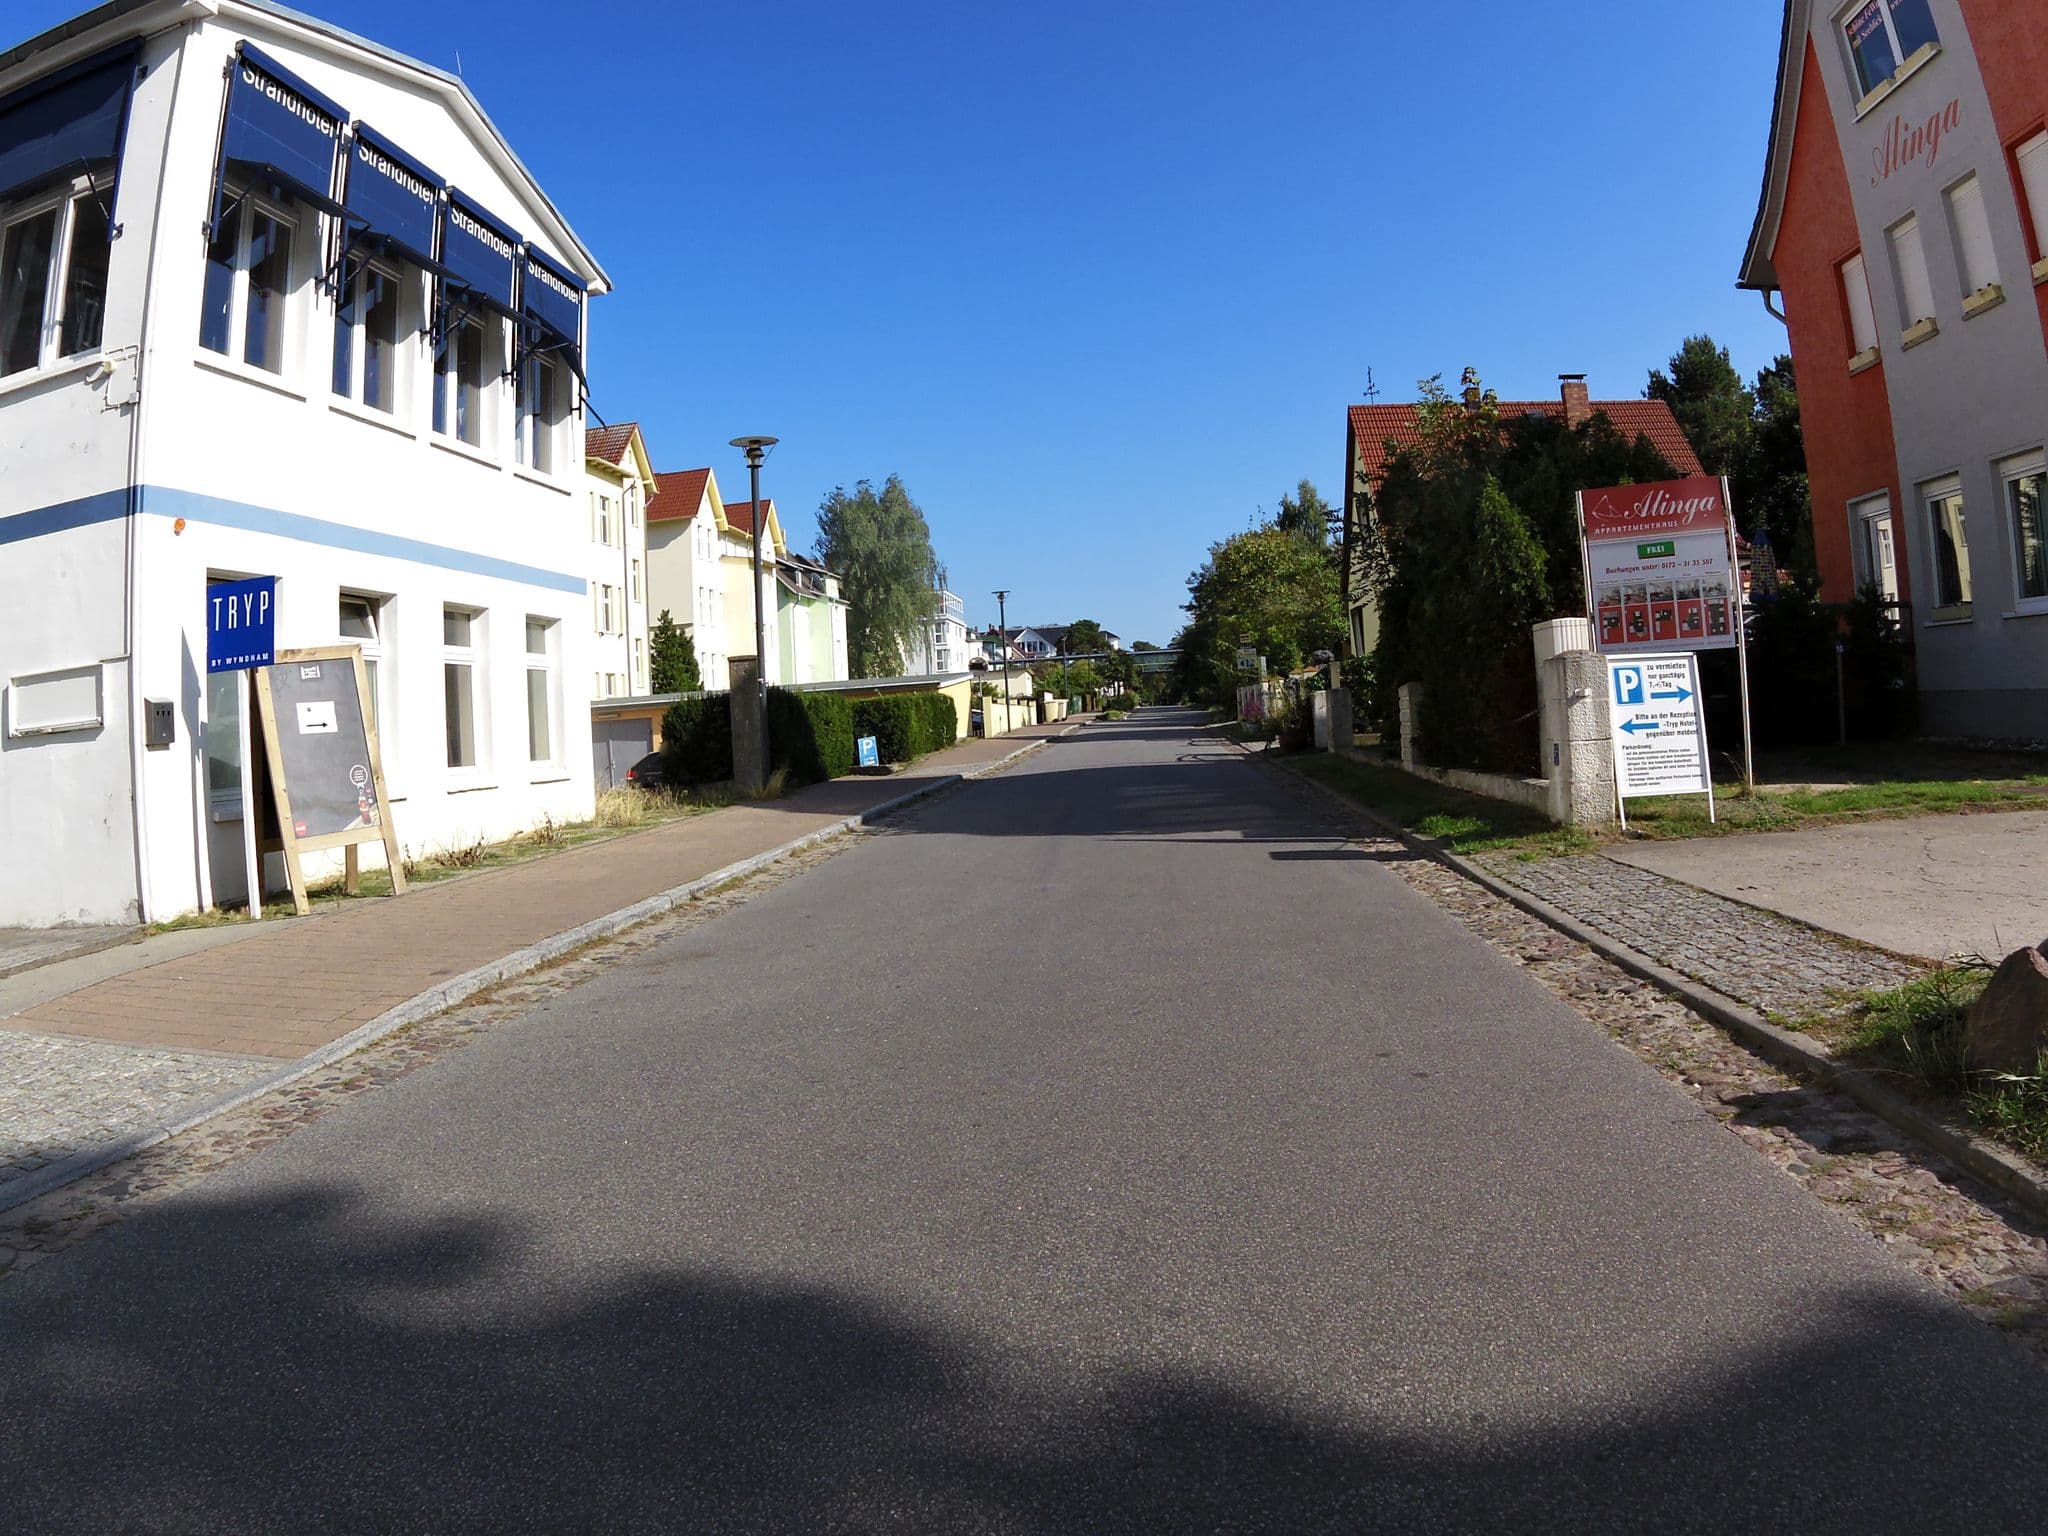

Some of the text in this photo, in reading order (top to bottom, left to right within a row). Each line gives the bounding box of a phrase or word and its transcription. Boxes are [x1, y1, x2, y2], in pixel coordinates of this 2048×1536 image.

[242, 59, 334, 138] Strandhotel
[1871, 98, 1961, 188] Alinga
[358, 140, 434, 205] Strandhotel
[450, 204, 512, 261] Strandhotel
[1624, 489, 1717, 526] Alinga
[1593, 520, 1679, 535] APPARTEMENTHAUS
[1646, 544, 1665, 555] FREI
[1605, 565, 1641, 575] Buchungen
[213, 590, 269, 632] TRYP
[211, 652, 269, 667] BY WYNDHAM
[1656, 662, 1687, 670] vermieten
[1618, 669, 1639, 703] P
[1635, 712, 1649, 721] Bitte
[1669, 711, 1697, 720] Rezeption
[1645, 730, 1675, 739] gegenüber
[863, 739, 874, 755] P
